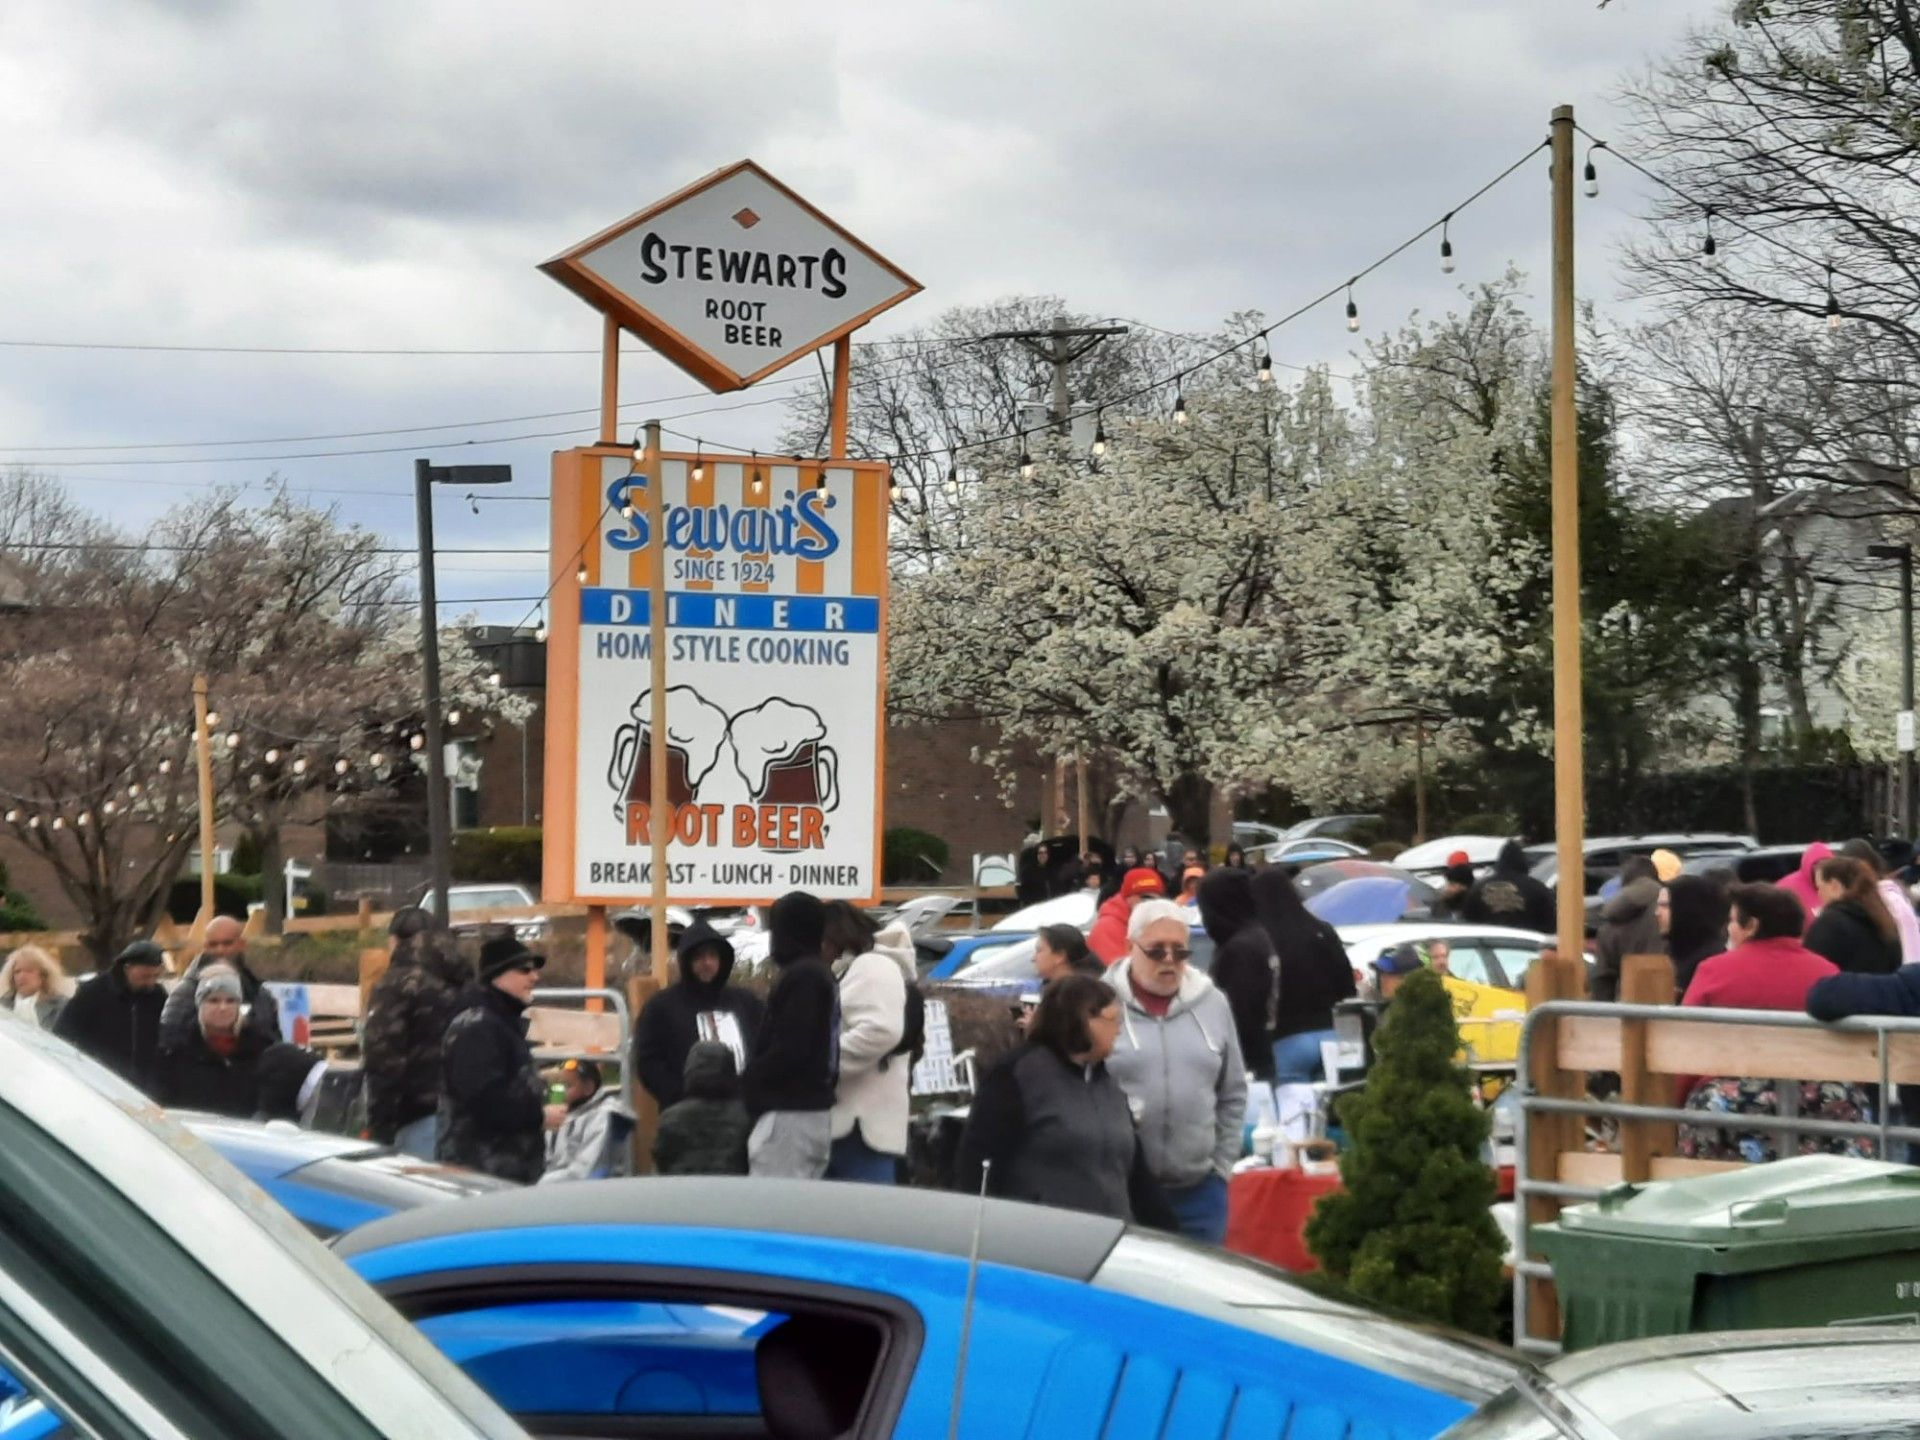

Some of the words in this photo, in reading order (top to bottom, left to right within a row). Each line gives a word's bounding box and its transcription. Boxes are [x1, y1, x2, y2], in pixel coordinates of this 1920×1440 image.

[640, 232, 847, 299] STEWARTS
[705, 299, 767, 322] ROOT
[725, 324, 782, 348] BEER
[674, 558, 725, 581] SINCE
[731, 562, 775, 582] 1924
[610, 594, 845, 630] DINER
[597, 632, 652, 660] HOM
[672, 634, 740, 662] STYLE
[747, 637, 850, 666] COOKING
[732, 804, 824, 849] BEER
[590, 862, 696, 884] BREAKAST
[712, 863, 772, 885] LUNCH
[789, 864, 858, 886] DINNER
